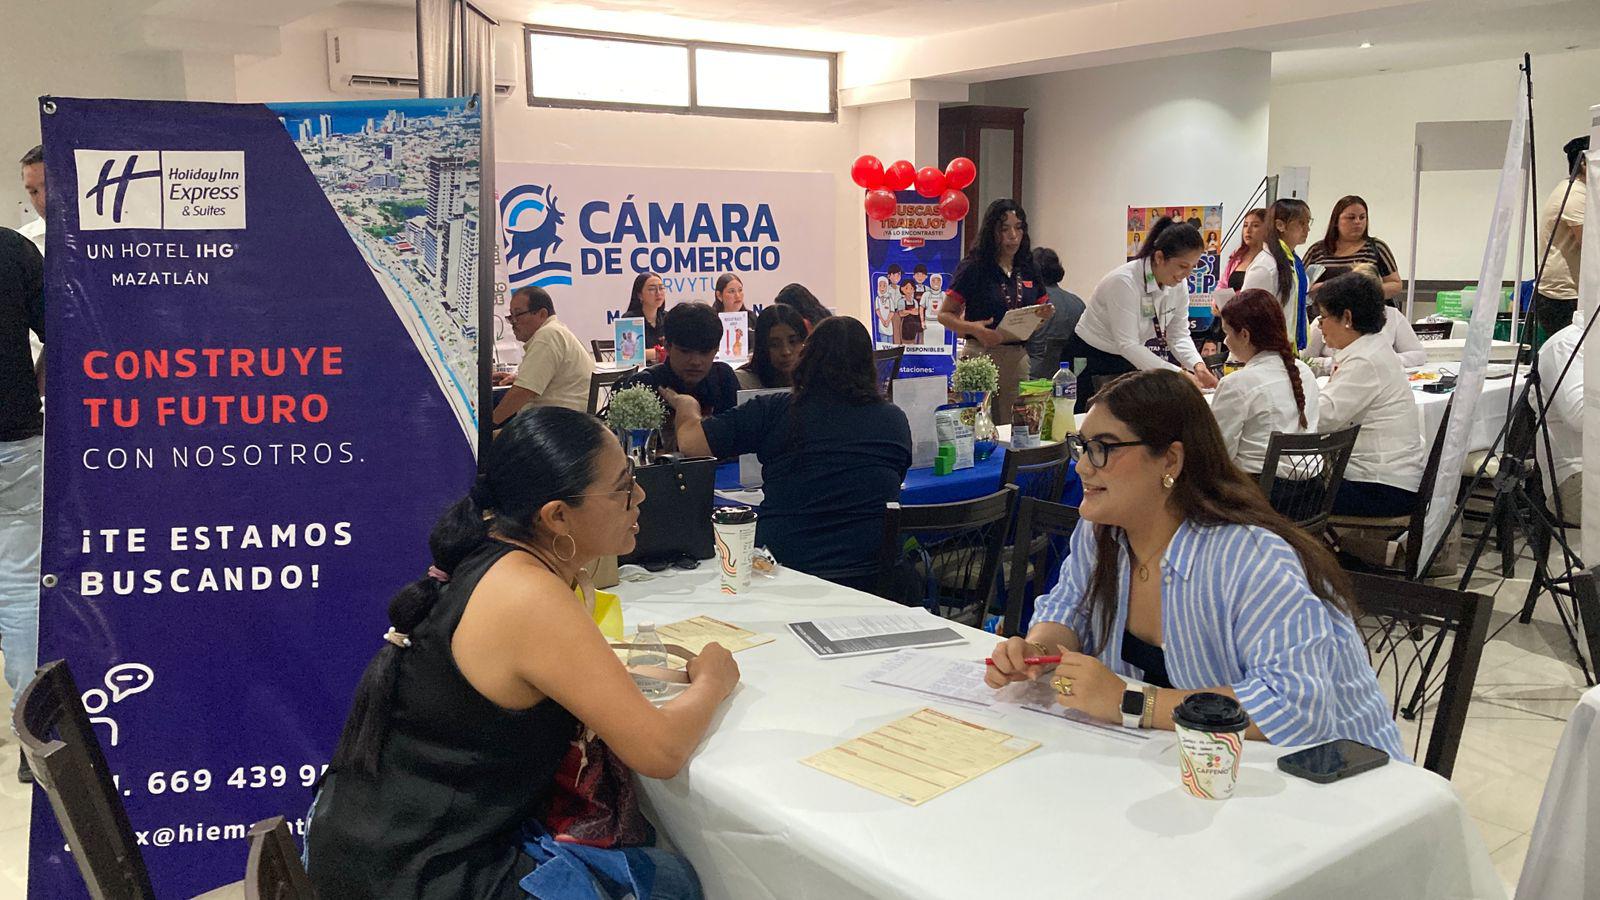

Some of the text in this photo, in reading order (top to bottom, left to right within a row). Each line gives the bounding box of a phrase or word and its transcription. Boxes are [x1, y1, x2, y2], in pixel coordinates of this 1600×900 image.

[168, 168, 240, 183] Holiday Inn
[169, 184, 240, 204] Express
[182, 206, 226, 216] & Suites
[578, 194, 780, 244] CÁMARA
[880, 217, 947, 229] TRABAJO?
[893, 205, 940, 217] USCAS
[87, 243, 114, 260] UN
[121, 243, 190, 258] HOTEL
[580, 245, 780, 275] DE COMERCIO
[112, 269, 209, 286] MAZATLÁN
[663, 277, 717, 293] RVYTU
[83, 346, 343, 380] CONSTRUYE
[83, 394, 329, 428] TU FUTURO
[82, 442, 364, 470] CON NOSOTROS.
[81, 521, 352, 553] ¡TE ESTAMOS
[80, 564, 319, 596] BUSCANDO!
[147, 769, 212, 794] 669
[226, 766, 287, 789] 439
